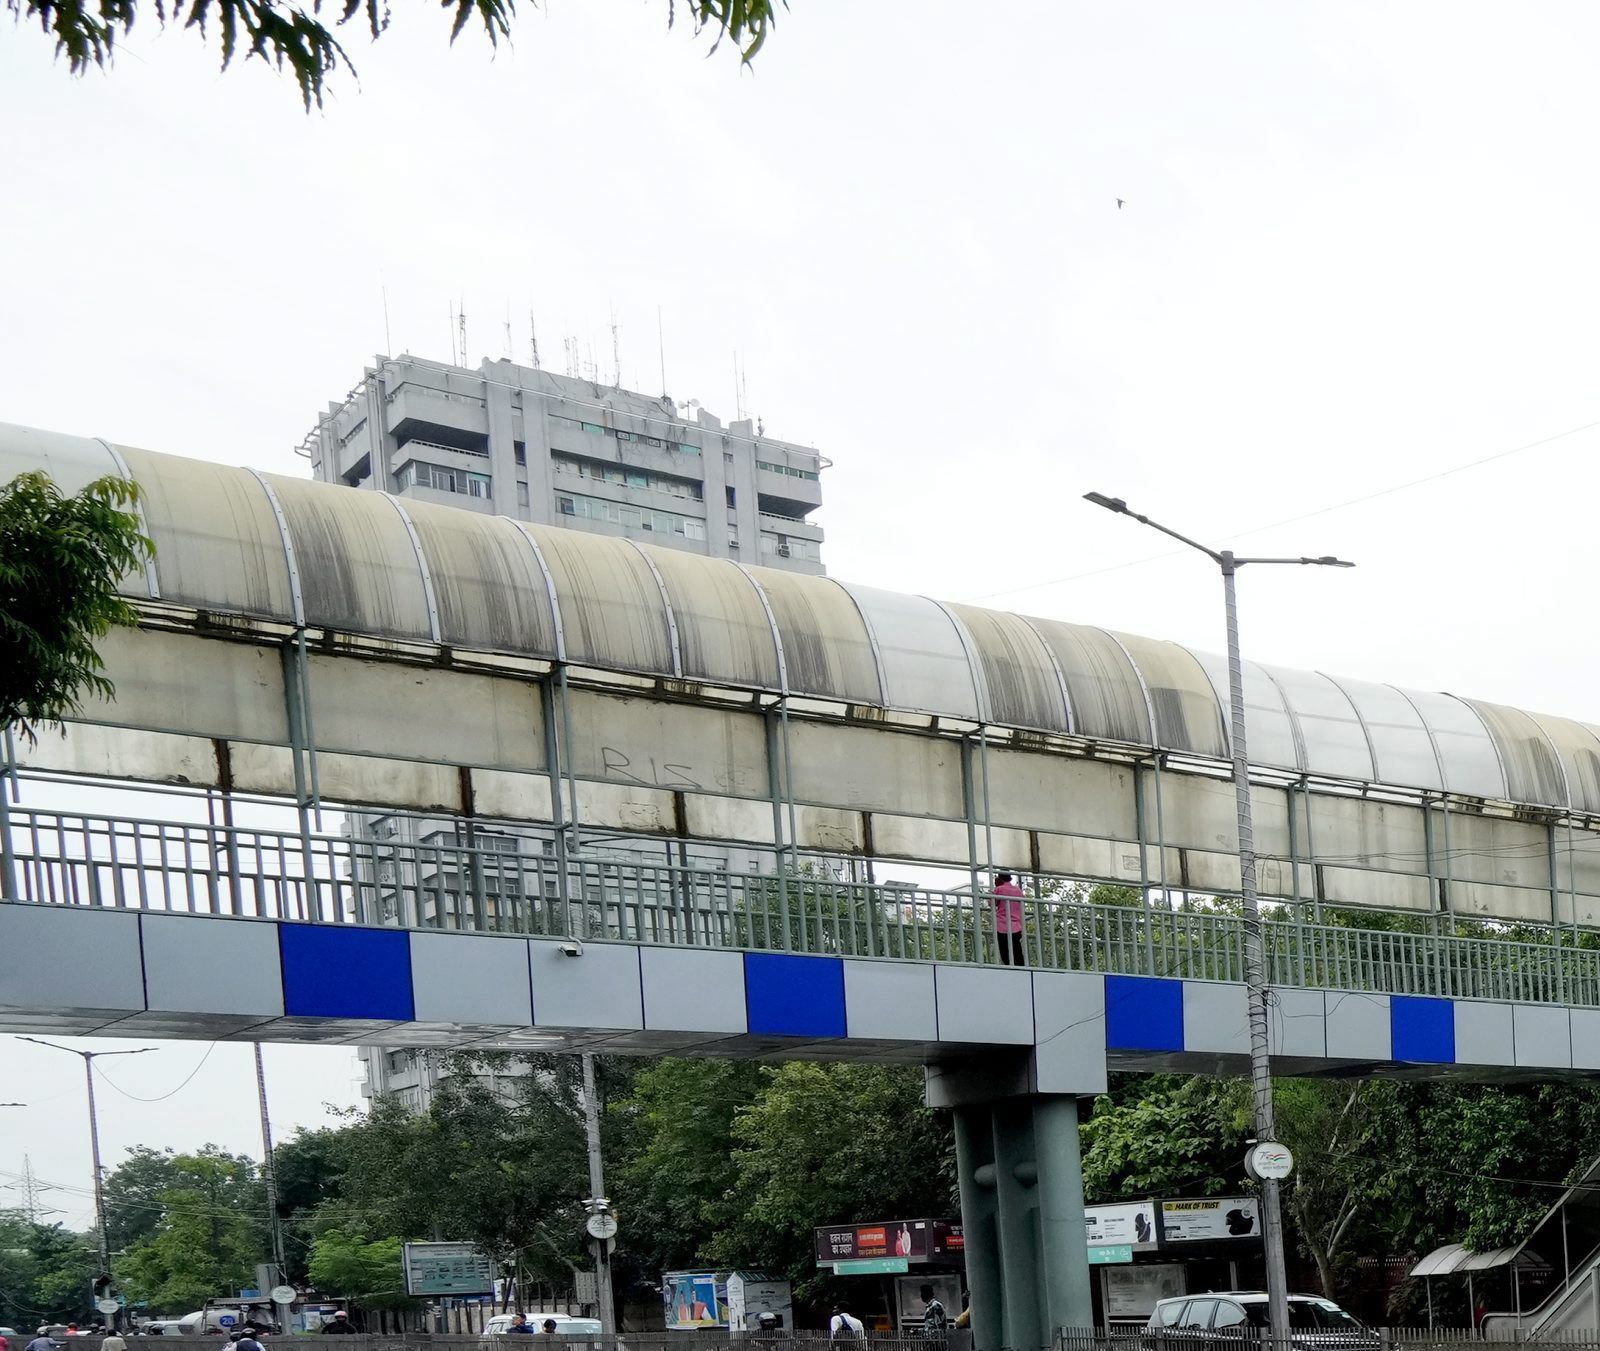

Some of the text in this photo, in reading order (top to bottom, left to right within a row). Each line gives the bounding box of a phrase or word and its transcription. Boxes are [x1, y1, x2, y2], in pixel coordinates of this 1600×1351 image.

[1174, 1201, 1219, 1210] MARK OF TRUST
